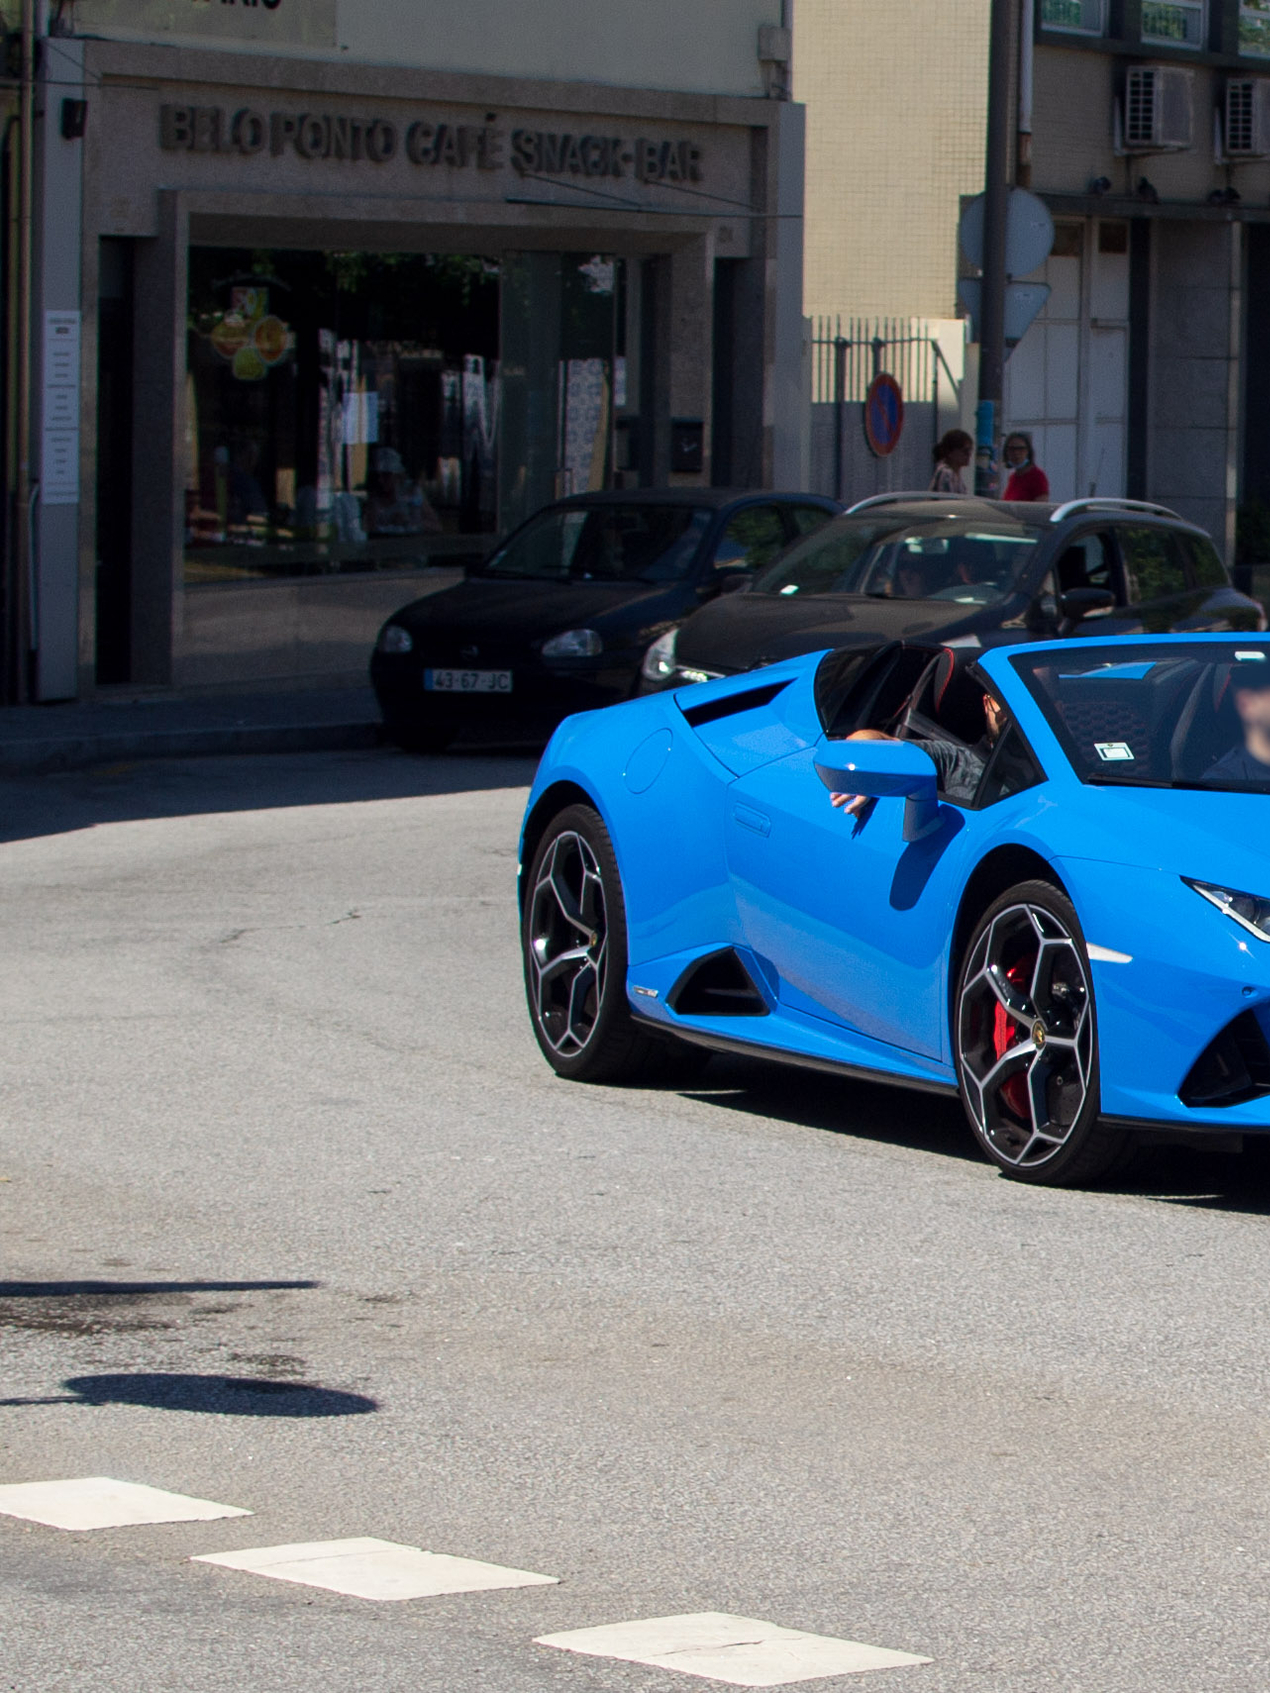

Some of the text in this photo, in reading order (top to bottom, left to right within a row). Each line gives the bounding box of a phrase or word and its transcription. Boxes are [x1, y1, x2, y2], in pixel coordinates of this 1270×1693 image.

[159, 104, 704, 182] BELO PONTO CAFÉ SNACK-BAR
